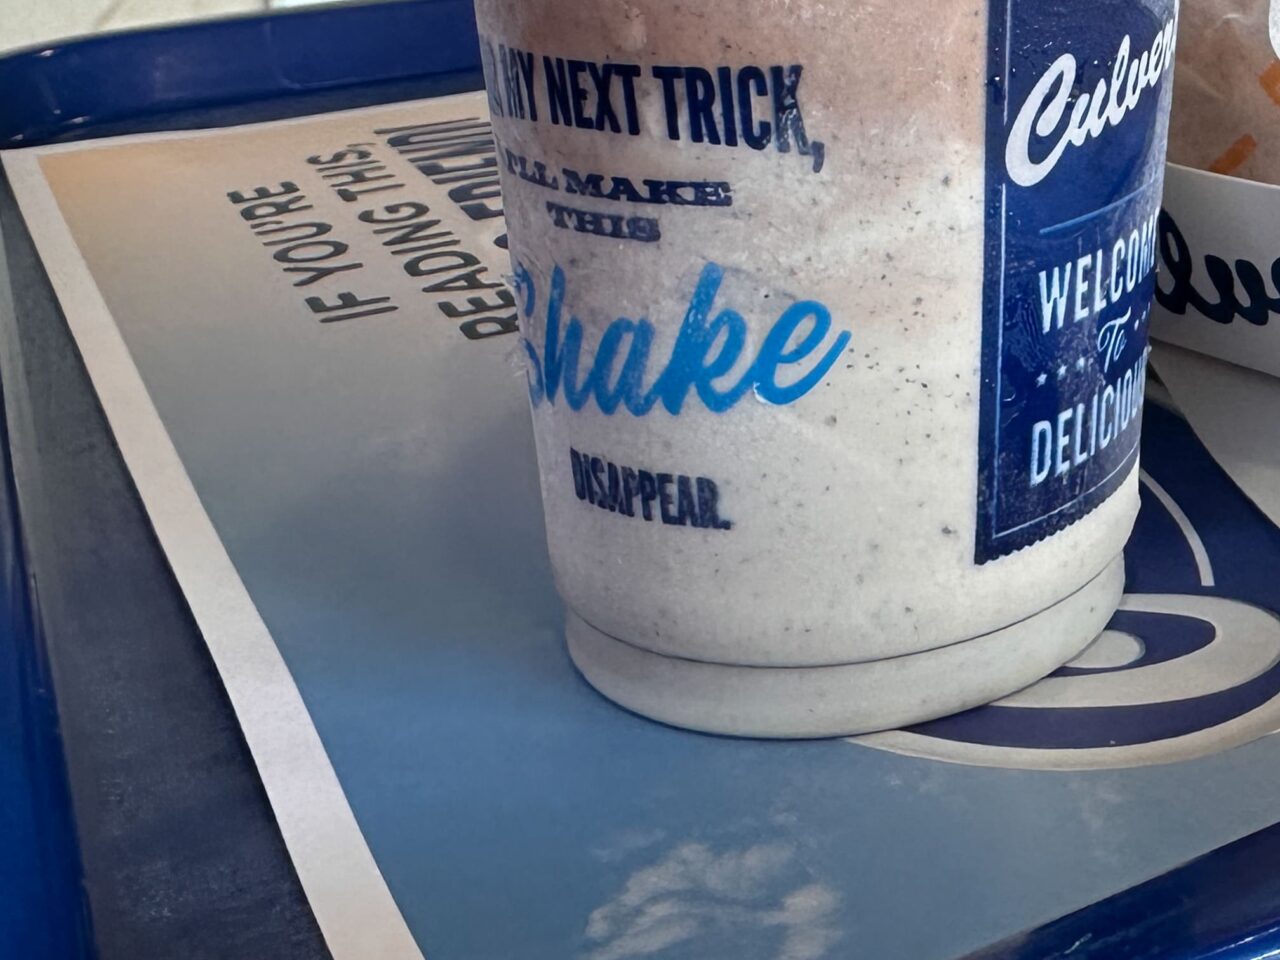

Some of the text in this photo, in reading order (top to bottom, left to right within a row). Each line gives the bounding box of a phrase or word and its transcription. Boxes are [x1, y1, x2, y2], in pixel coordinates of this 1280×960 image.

[542, 55, 642, 136] NEXT
[652, 63, 826, 174] TRICK,
[545, 200, 663, 243] THIS
[561, 167, 733, 207] MAKE
[226, 180, 400, 324] IF YOU'RE
[305, 141, 520, 341] READING THIS,
[1097, 310, 1135, 375] To
[570, 447, 736, 532] DISAPPEAR.
